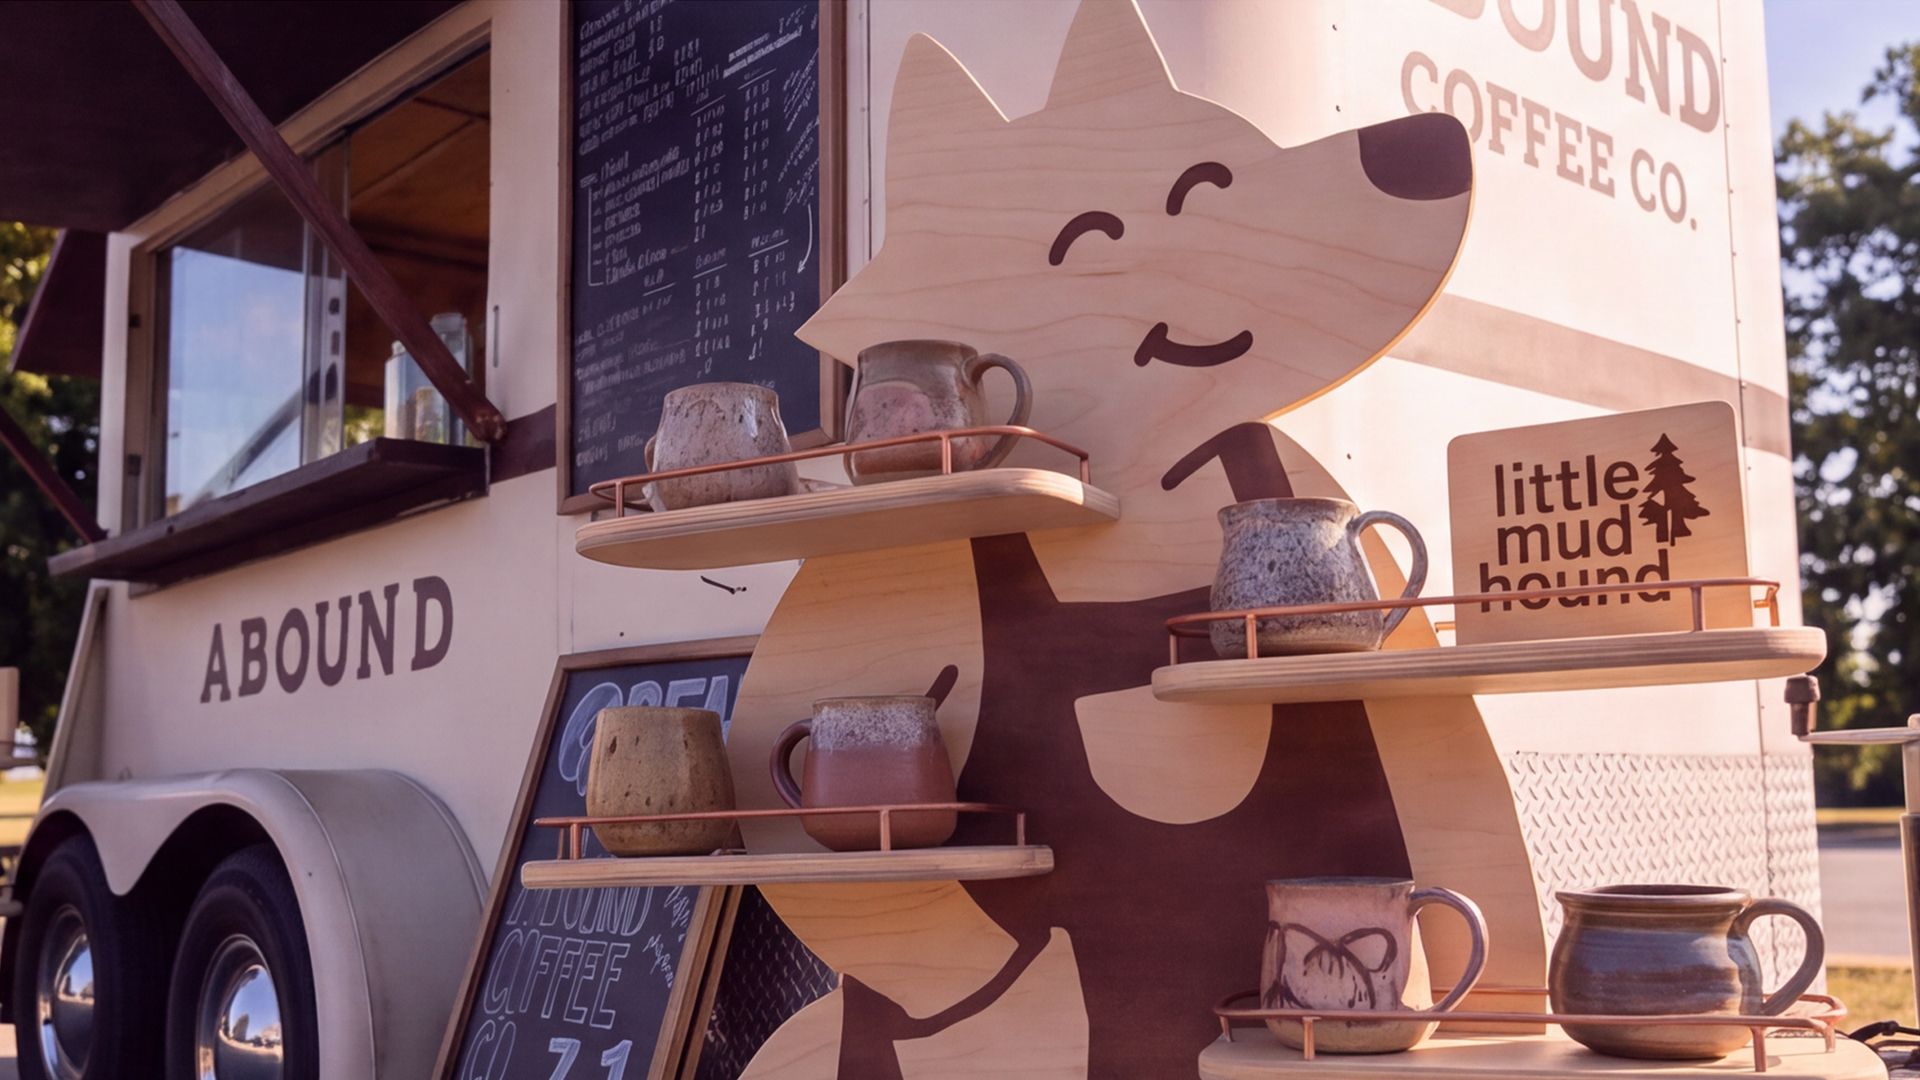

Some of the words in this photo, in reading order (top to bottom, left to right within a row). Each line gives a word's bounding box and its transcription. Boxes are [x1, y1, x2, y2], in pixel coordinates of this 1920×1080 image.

[1427, 0, 1721, 133] OUND
[1401, 51, 1616, 199] COFFEE
[1630, 148, 1697, 231] CO.
[1494, 454, 1640, 517] little
[1479, 548, 1671, 613] hound
[1497, 503, 1633, 566] mud
[200, 575, 454, 704] ABOUND
